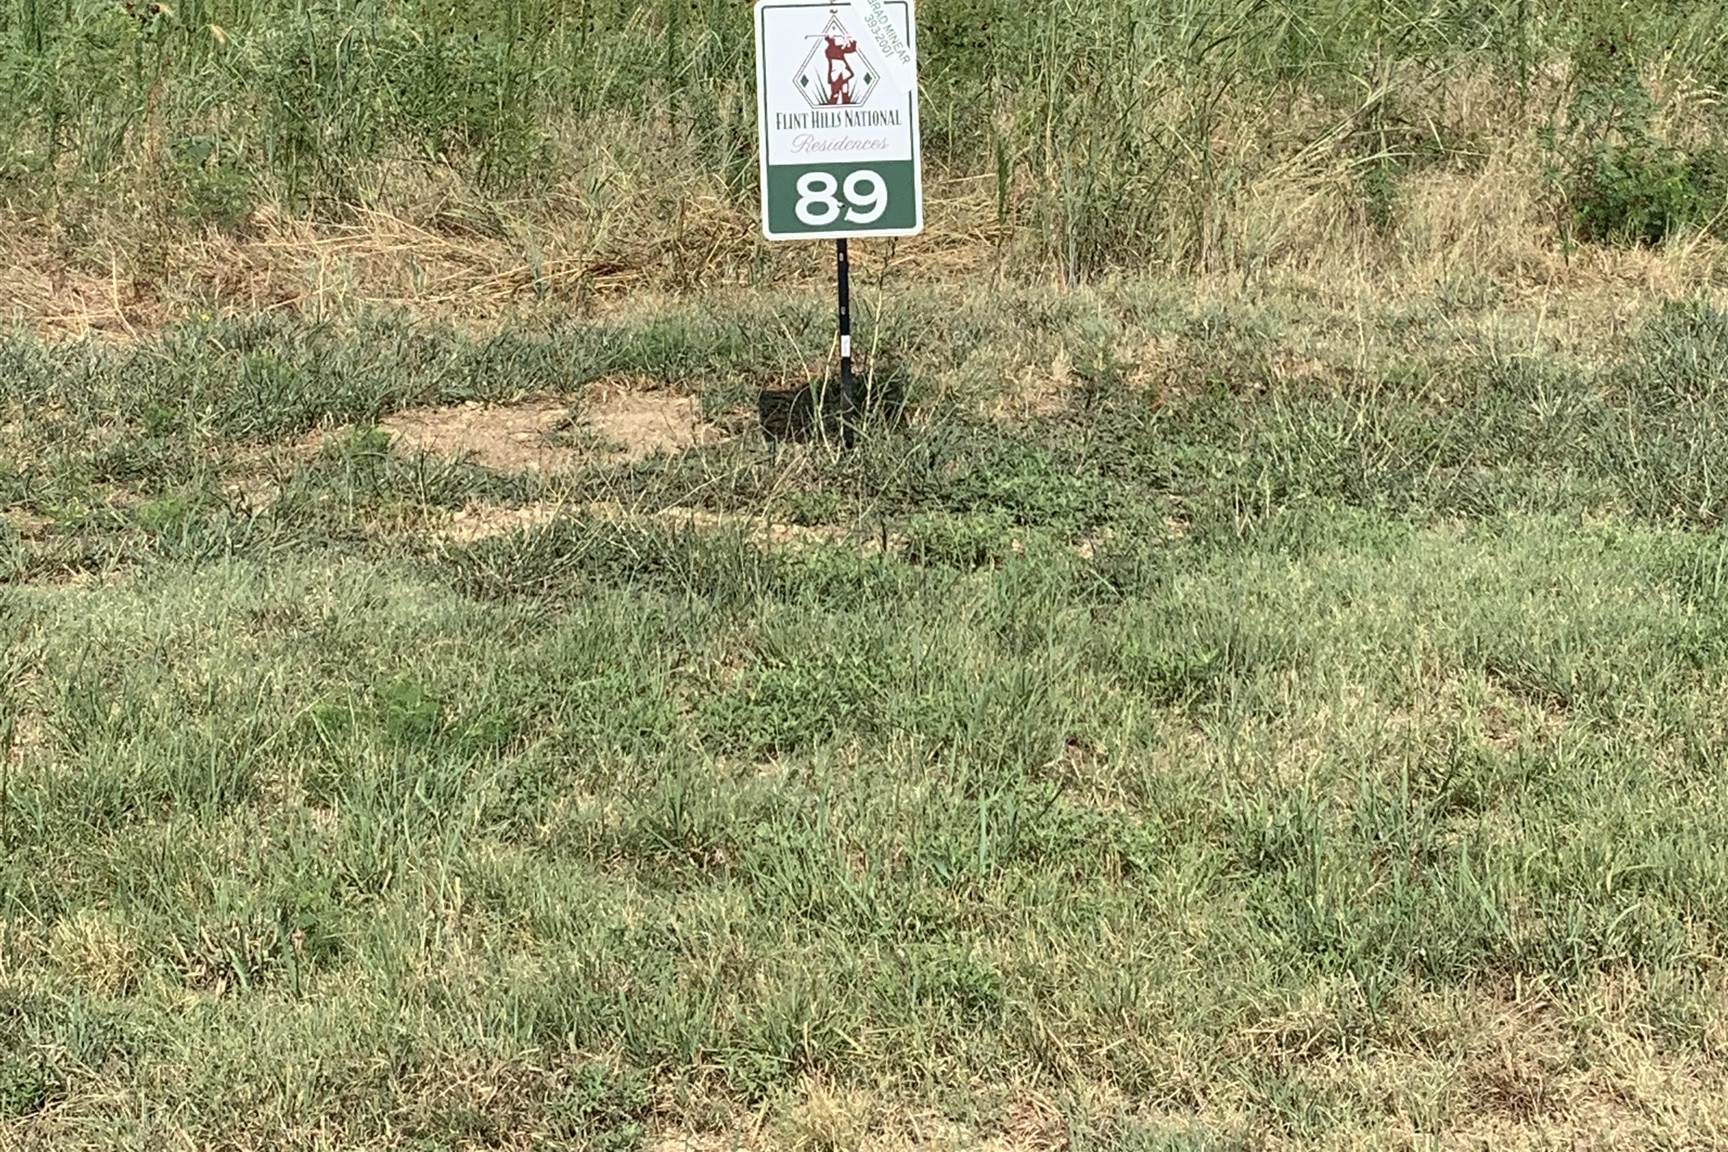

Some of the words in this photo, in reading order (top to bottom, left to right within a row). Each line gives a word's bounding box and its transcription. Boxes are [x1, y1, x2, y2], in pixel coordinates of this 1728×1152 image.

[883, 23, 911, 65] MINEAR
[776, 112, 809, 130] FLINT
[811, 111, 842, 129] HILLS
[845, 109, 902, 128] NATIONAL
[791, 133, 890, 154] Residences
[794, 169, 888, 226] 89
